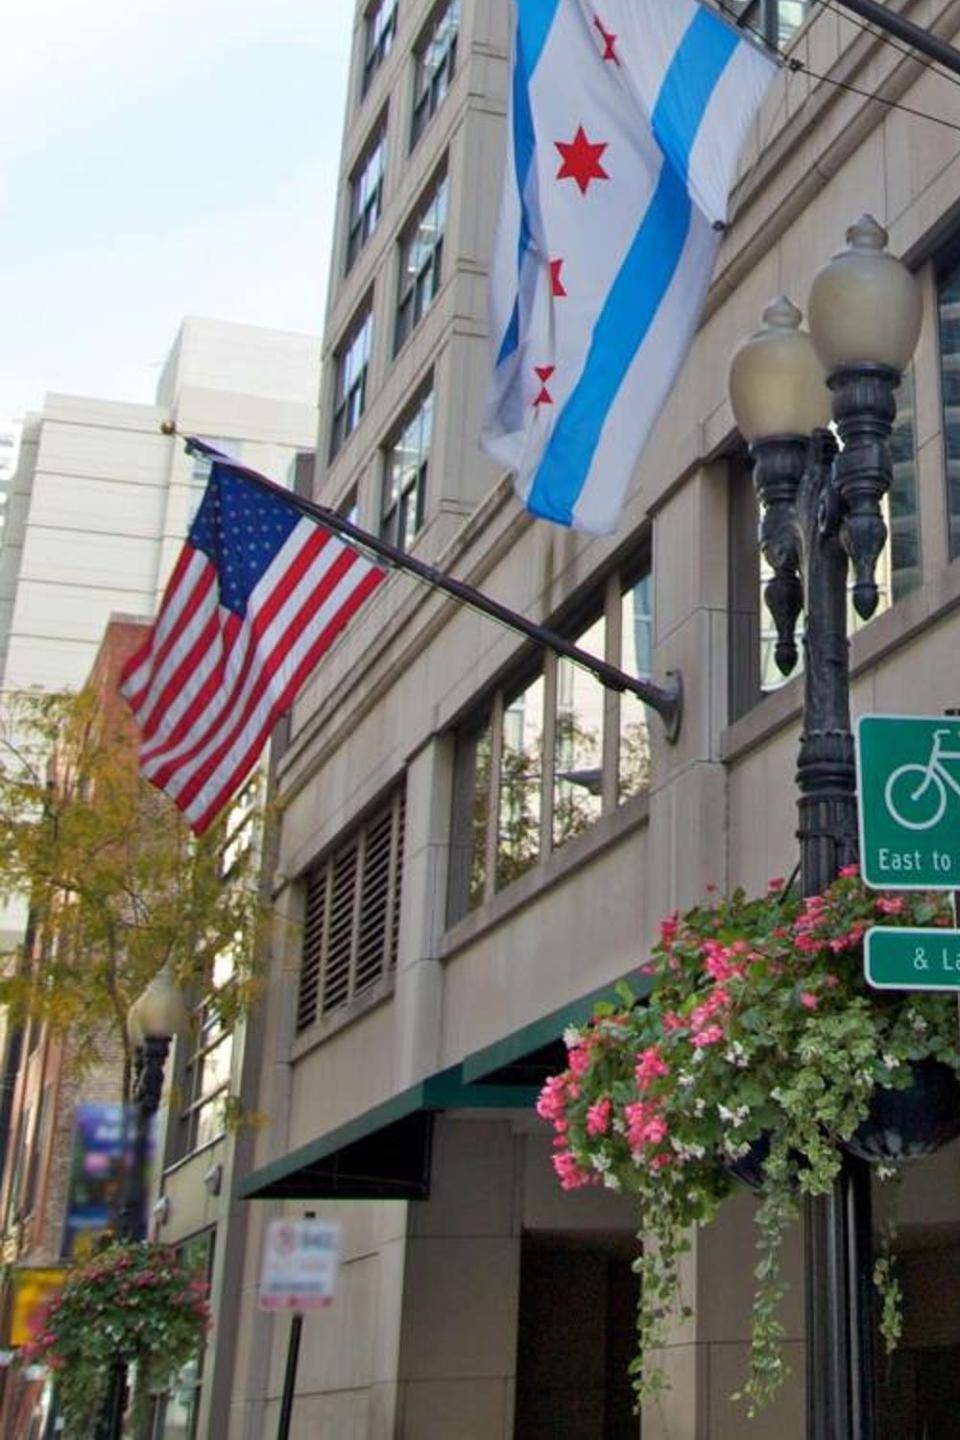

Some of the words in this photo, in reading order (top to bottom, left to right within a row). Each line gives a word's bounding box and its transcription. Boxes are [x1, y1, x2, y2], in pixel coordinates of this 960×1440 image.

[878, 848, 922, 871] East
[932, 850, 951, 871] to
[913, 947, 929, 970] &
